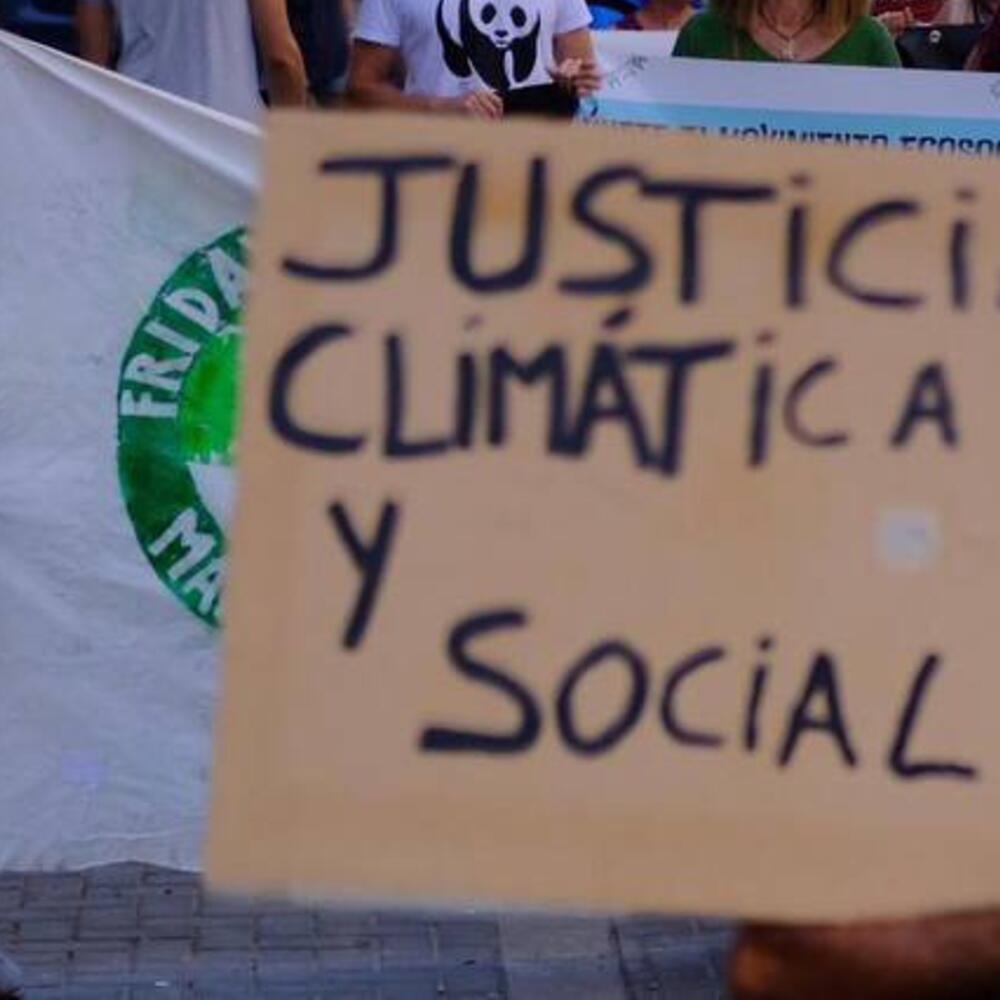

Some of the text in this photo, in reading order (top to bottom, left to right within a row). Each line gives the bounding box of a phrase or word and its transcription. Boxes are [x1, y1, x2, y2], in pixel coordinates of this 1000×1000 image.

[119, 236, 248, 418] FRIDA
[147, 507, 226, 617] MA
[326, 498, 402, 653] Y
